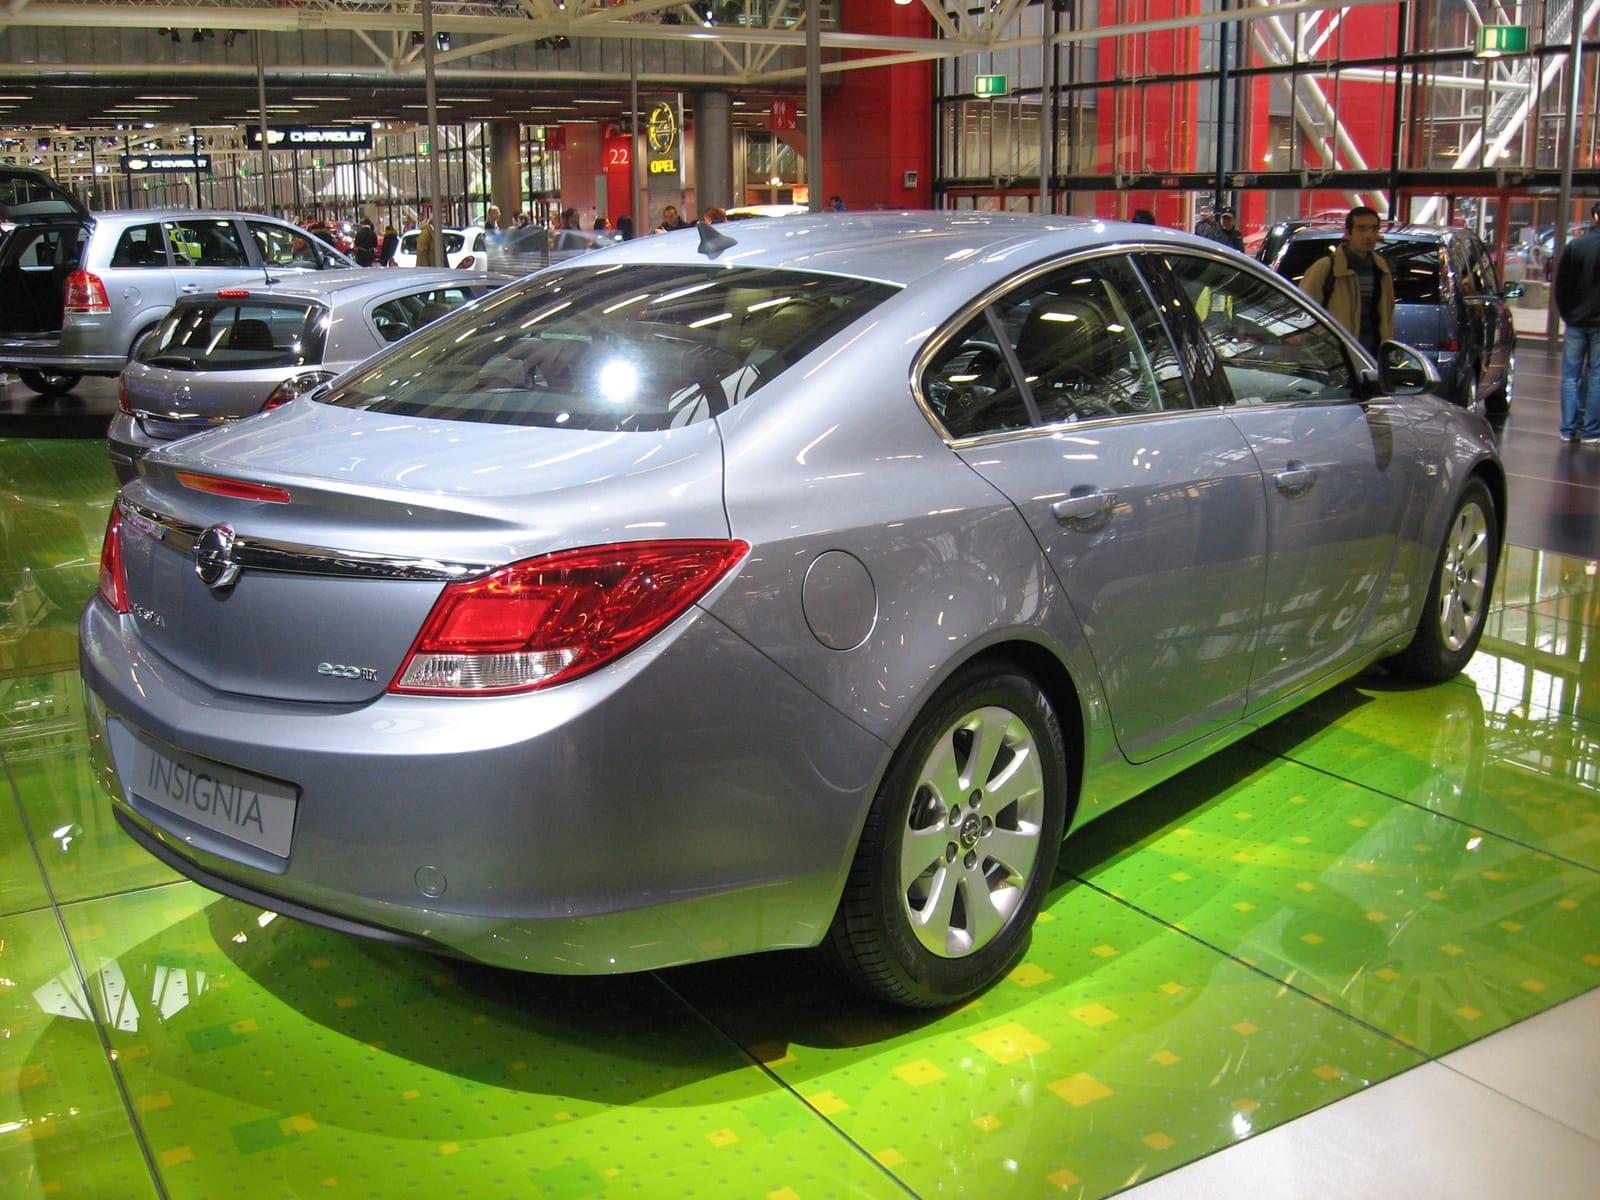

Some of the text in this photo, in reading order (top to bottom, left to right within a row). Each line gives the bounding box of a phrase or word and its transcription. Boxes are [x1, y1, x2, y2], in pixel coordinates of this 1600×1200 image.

[289, 131, 367, 142] CHEVROLET
[609, 148, 630, 165] 22
[650, 159, 677, 174] OPEL
[149, 751, 264, 834] INSIGNIA
